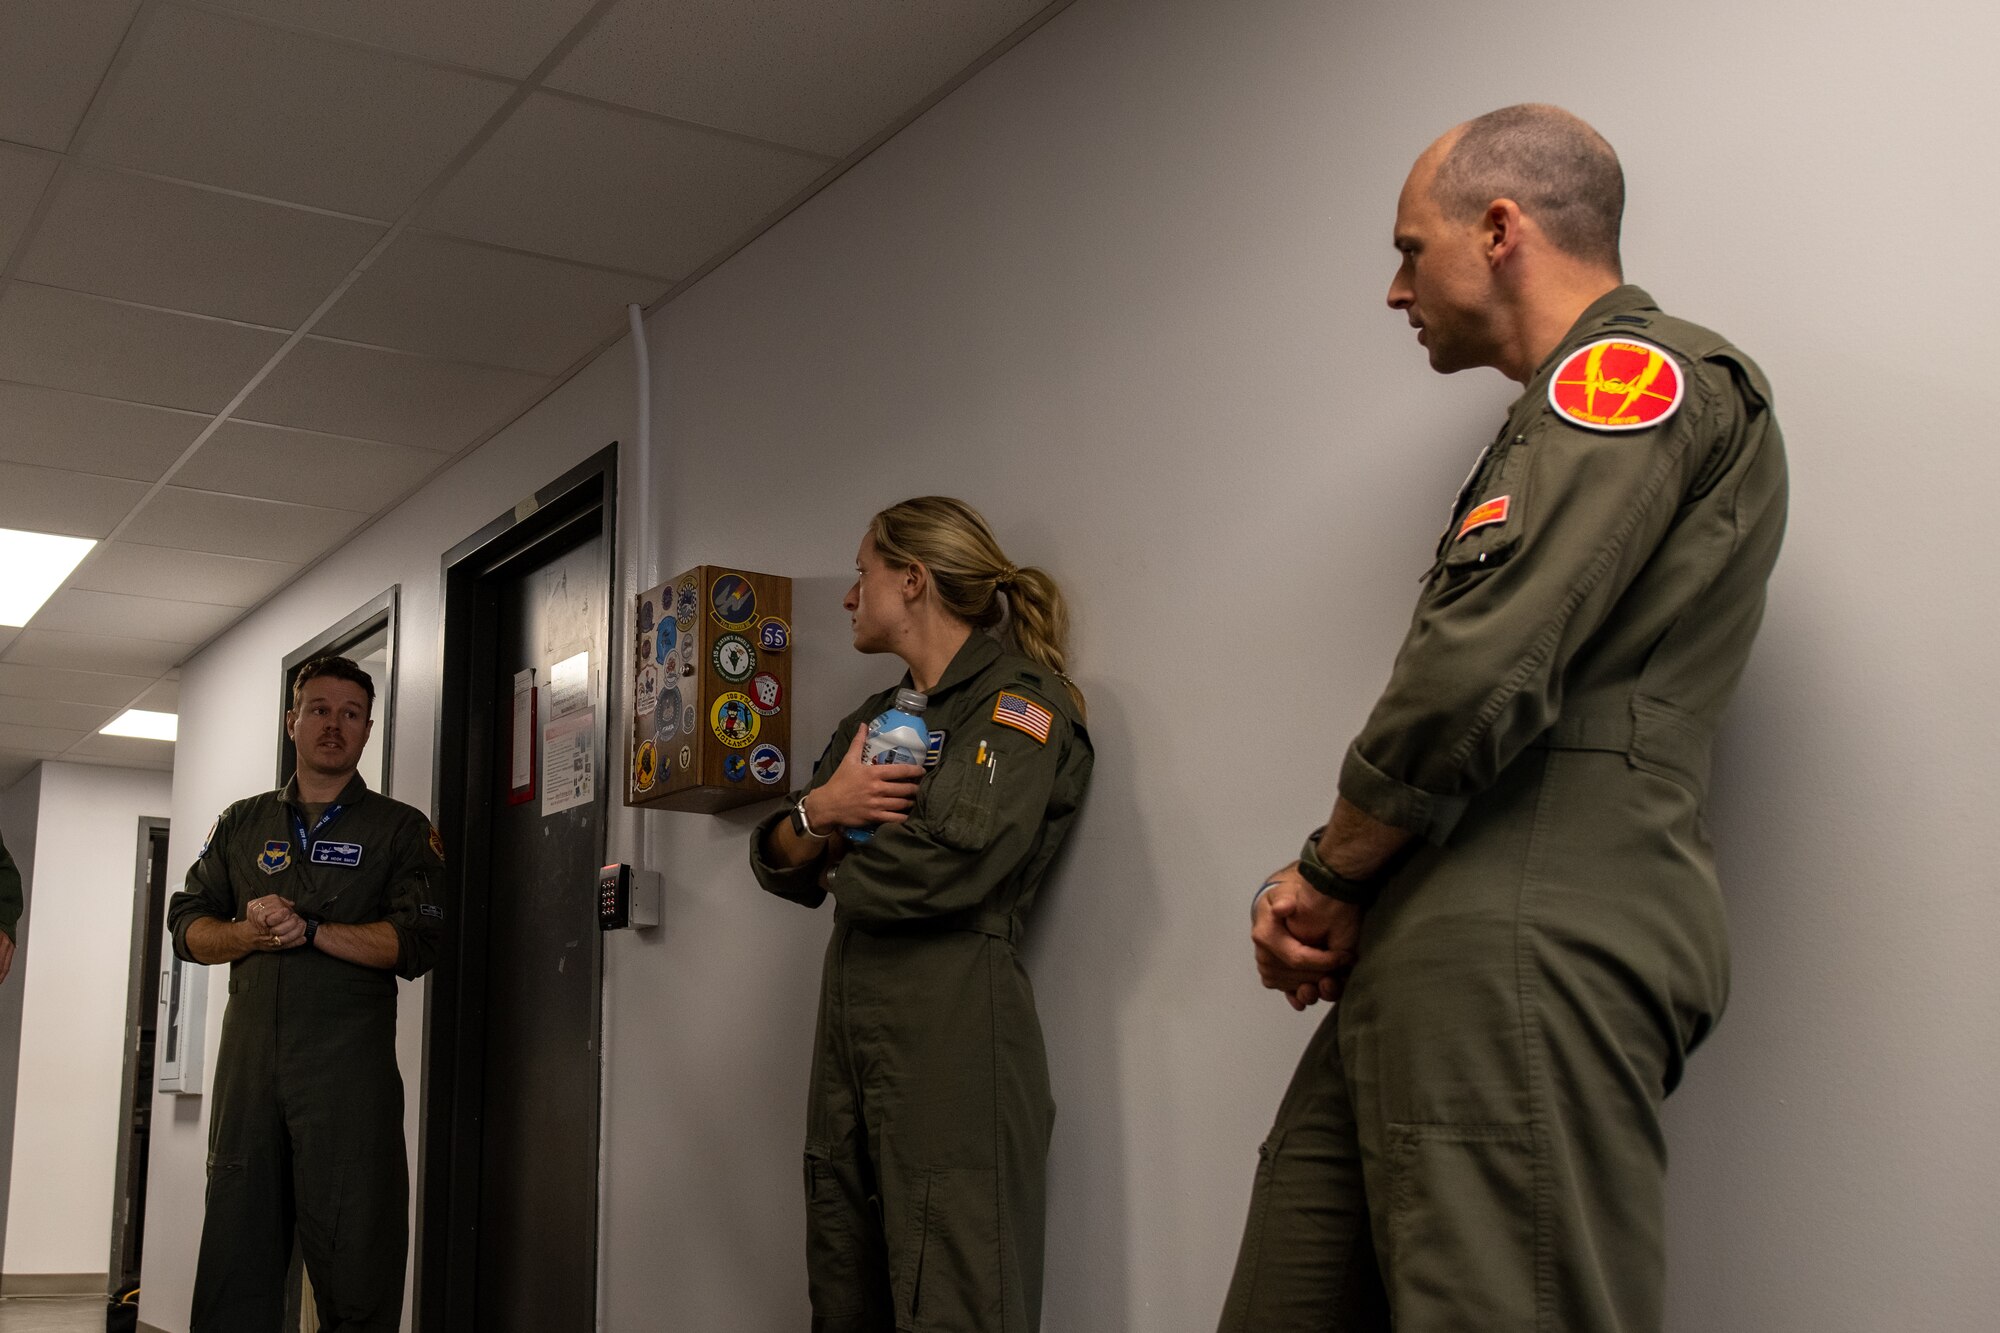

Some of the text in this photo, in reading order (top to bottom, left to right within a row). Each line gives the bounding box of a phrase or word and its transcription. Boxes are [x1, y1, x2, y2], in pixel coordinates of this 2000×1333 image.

[734, 636, 750, 648] ANGELS
[764, 628, 784, 646] 55
[714, 726, 755, 747] VIGILANTES
